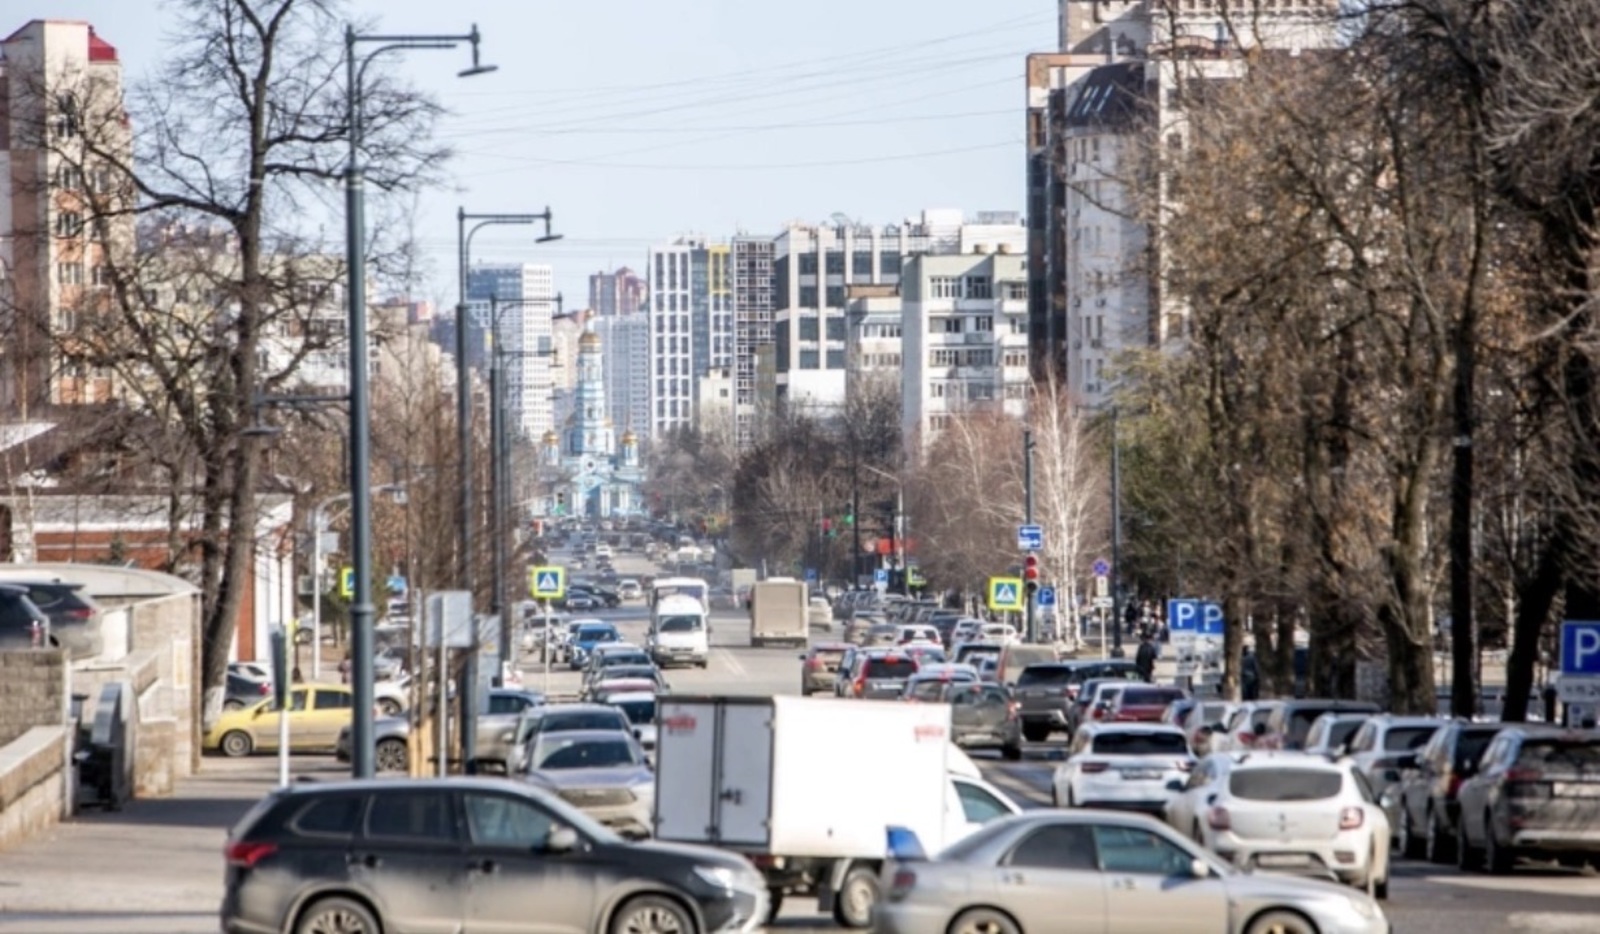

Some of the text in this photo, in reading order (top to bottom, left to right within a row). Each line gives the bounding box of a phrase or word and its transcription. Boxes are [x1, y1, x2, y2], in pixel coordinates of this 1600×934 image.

[1042, 588, 1052, 602] P
[1177, 603, 1194, 627] P
[1204, 605, 1223, 630] P
[1575, 628, 1600, 669] P
